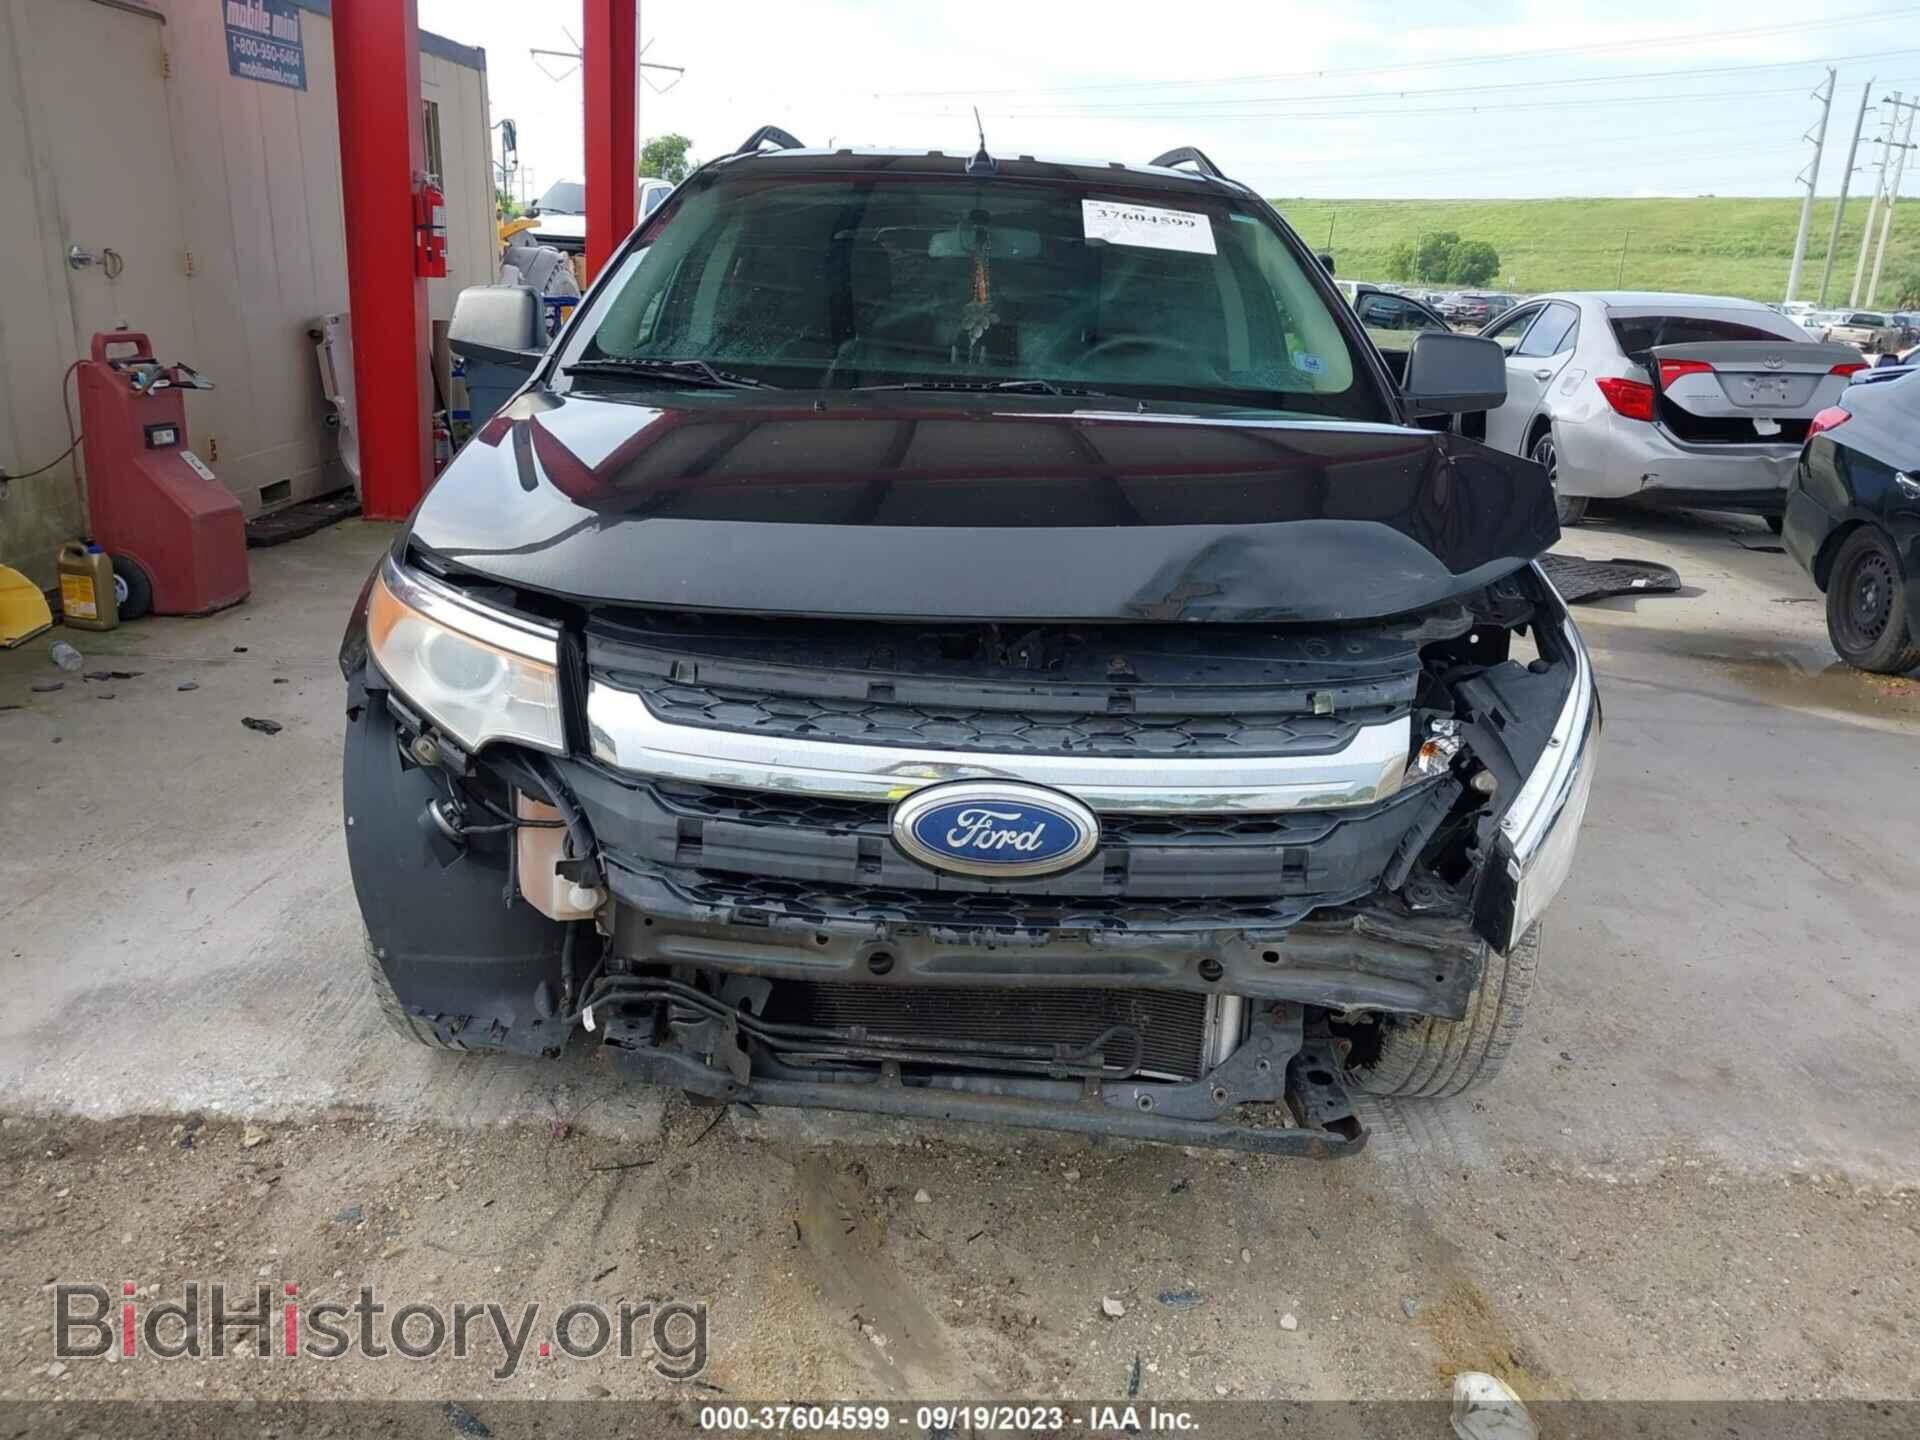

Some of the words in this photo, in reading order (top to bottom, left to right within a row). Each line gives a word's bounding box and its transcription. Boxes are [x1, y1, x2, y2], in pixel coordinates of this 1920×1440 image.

[226, 0, 271, 35] mobile
[272, 11, 298, 42] mini
[239, 60, 300, 87] mobilemini.com
[1097, 208, 1196, 228] 37604599
[946, 808, 1046, 851] Ford
